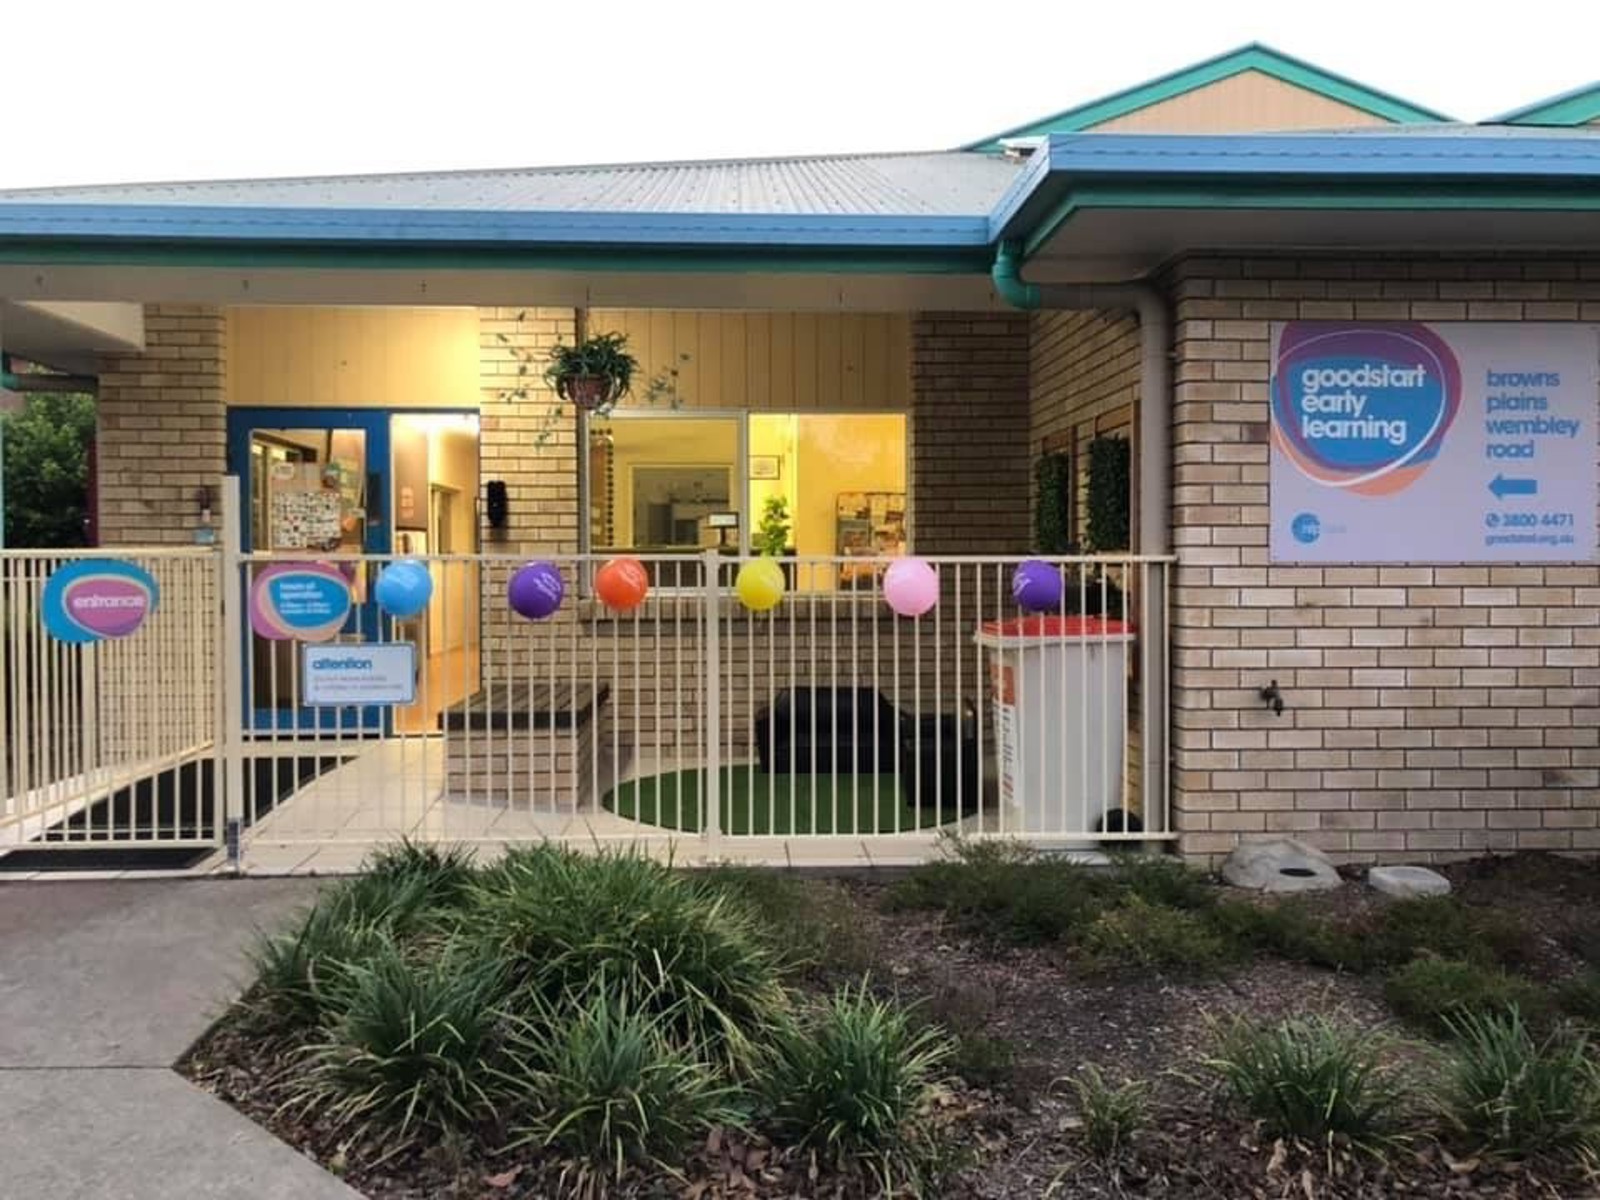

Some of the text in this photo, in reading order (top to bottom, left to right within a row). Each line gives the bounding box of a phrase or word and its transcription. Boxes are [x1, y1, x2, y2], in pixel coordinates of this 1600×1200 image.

[1302, 364, 1426, 393] goodstart
[1487, 368, 1560, 387] browns
[1301, 389, 1367, 418] early
[1487, 391, 1547, 414] plains
[1302, 414, 1406, 445] learning
[1486, 415, 1579, 438] wembley
[1487, 440, 1534, 458] road
[1541, 513, 1574, 527] 4471
[73, 594, 144, 609] entrance
[312, 657, 372, 670] attention
